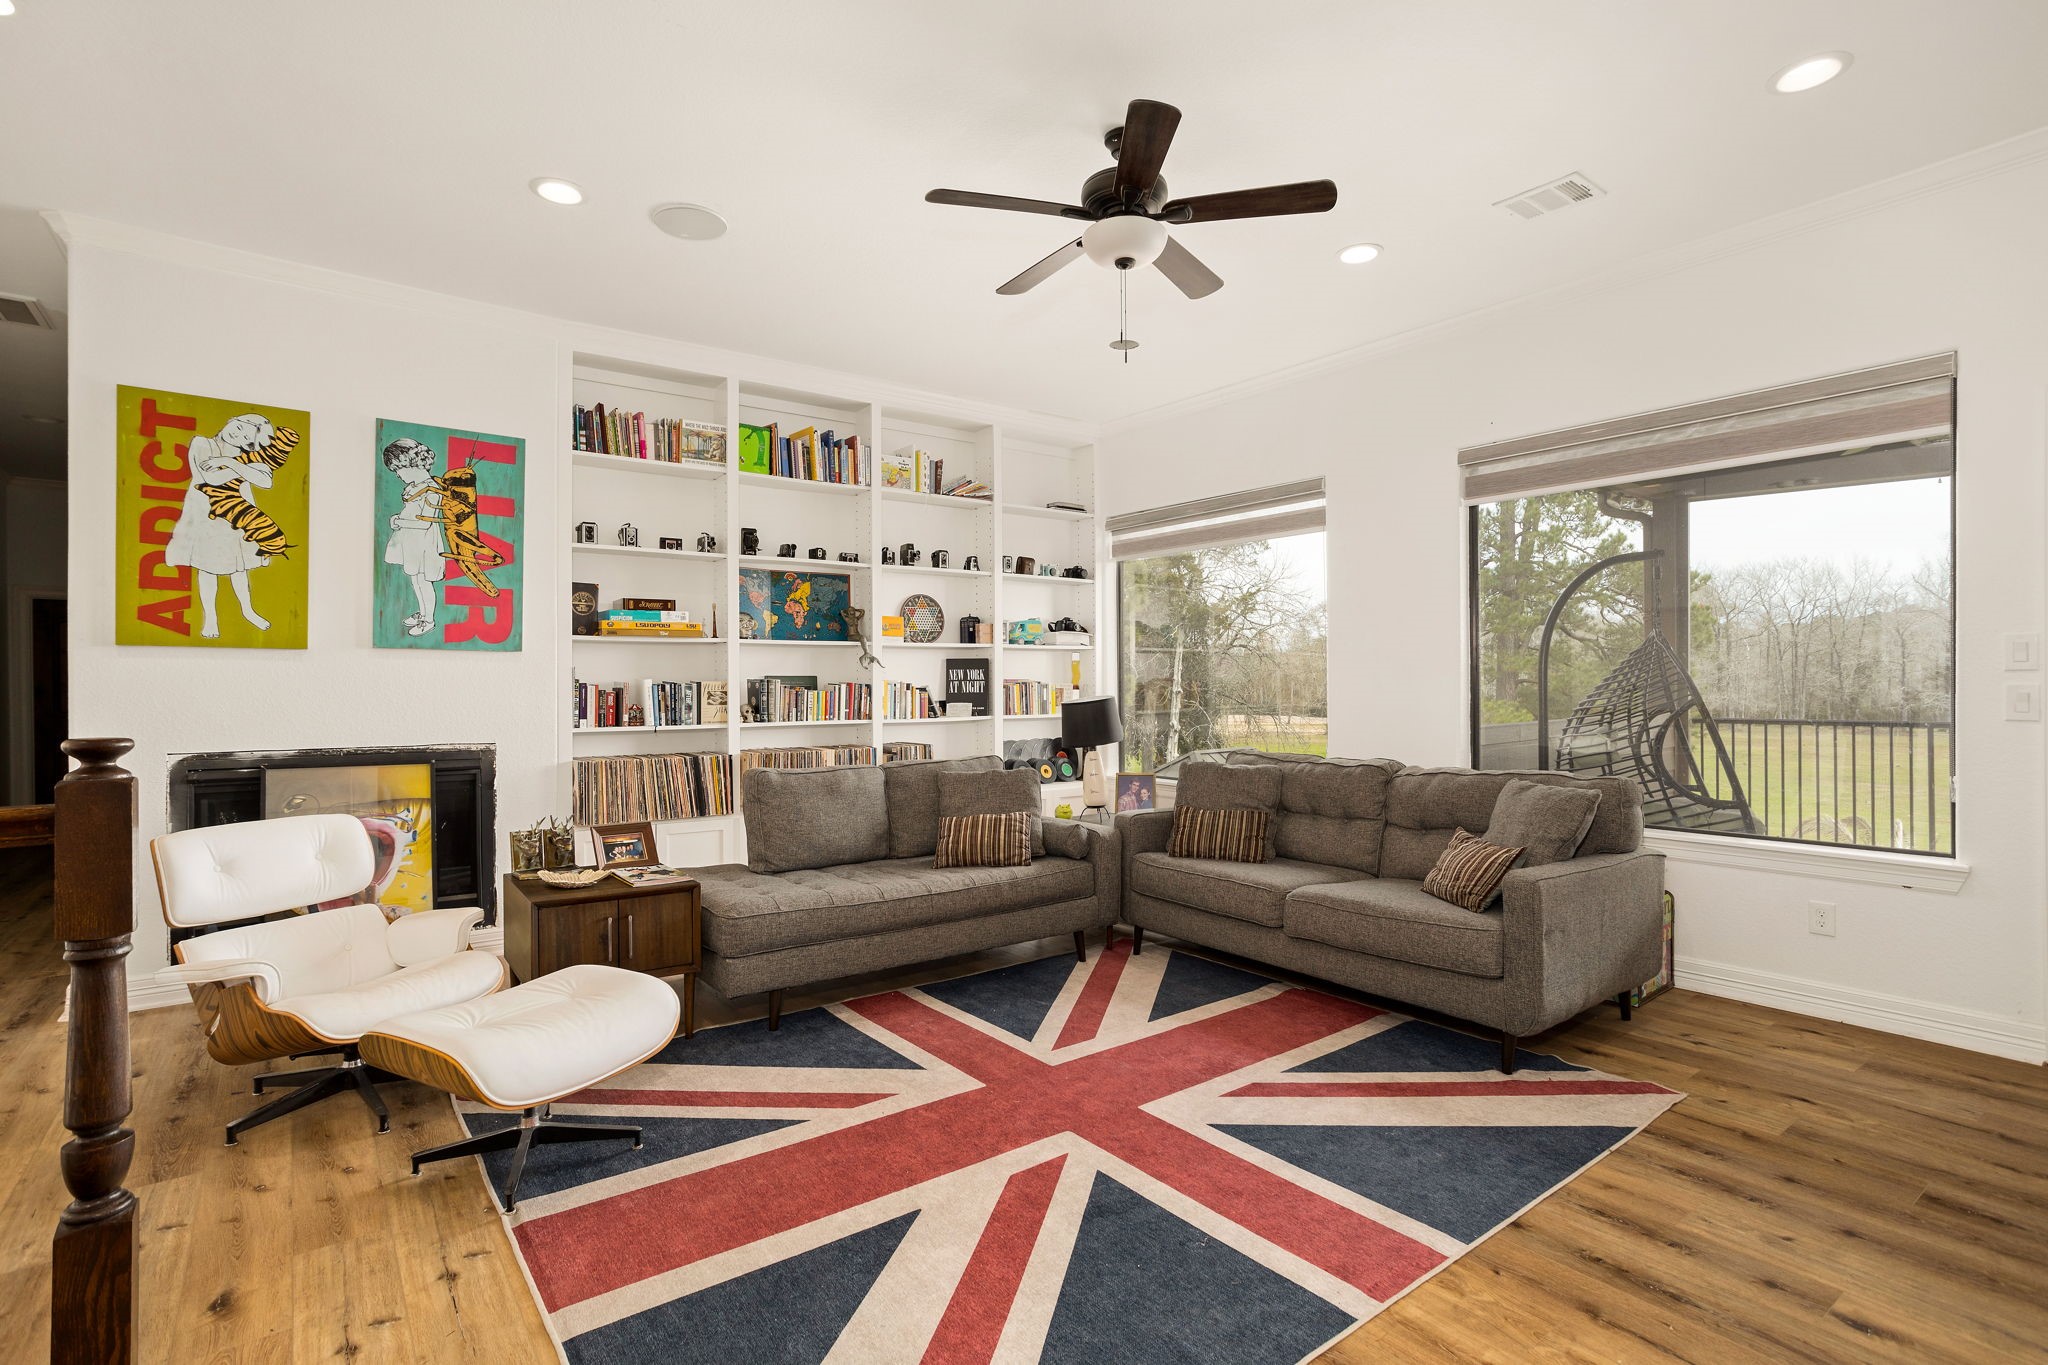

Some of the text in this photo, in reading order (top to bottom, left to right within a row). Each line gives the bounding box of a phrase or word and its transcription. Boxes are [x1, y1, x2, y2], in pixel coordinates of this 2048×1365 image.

[137, 398, 197, 637] ADDICT
[948, 669, 985, 681] NEW YORK
[948, 681, 986, 693] AT NIGHT
